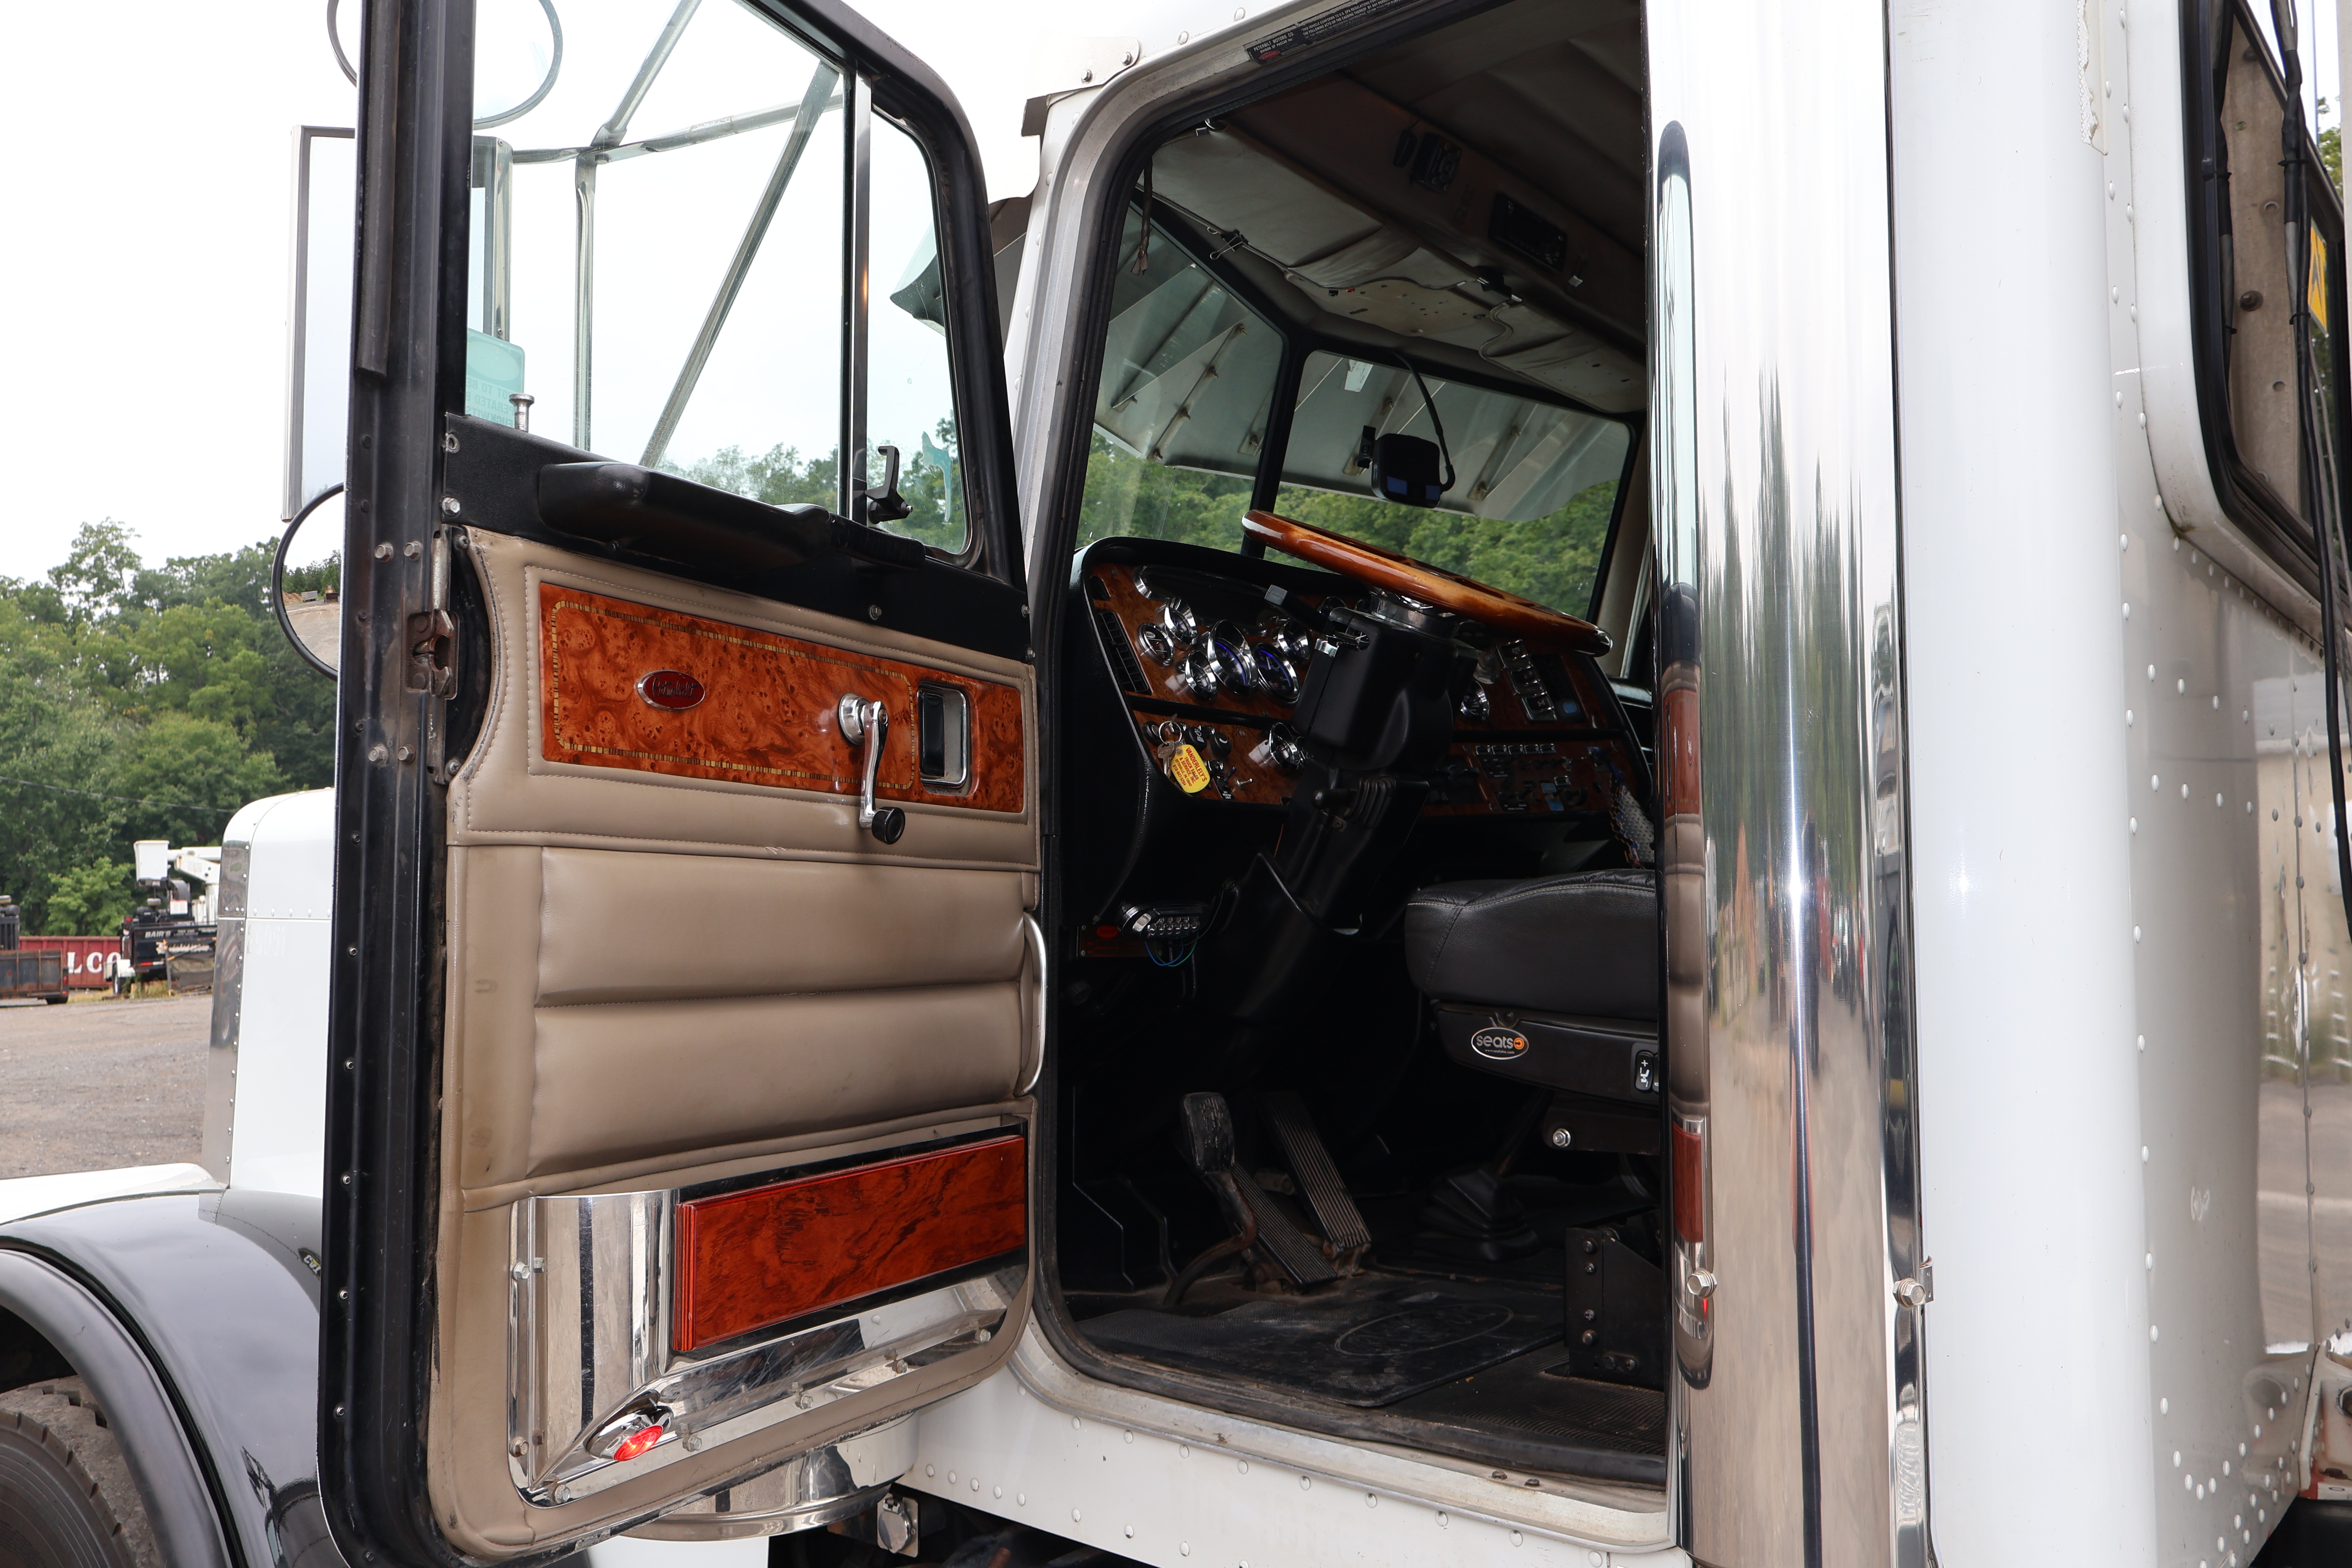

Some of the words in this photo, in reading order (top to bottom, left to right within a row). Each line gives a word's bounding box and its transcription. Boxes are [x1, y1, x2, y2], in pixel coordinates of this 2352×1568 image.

[1254, 41, 1272, 51] PETERBILT
[1272, 35, 1287, 44] MOTORS
[652, 677, 699, 698] Peterbilt
[1184, 756, 1193, 770] TRUCK
[1191, 768, 1199, 780] SALES
[1185, 747, 1207, 782] VANDERLELY'S
[1476, 1035, 1514, 1049] seats
